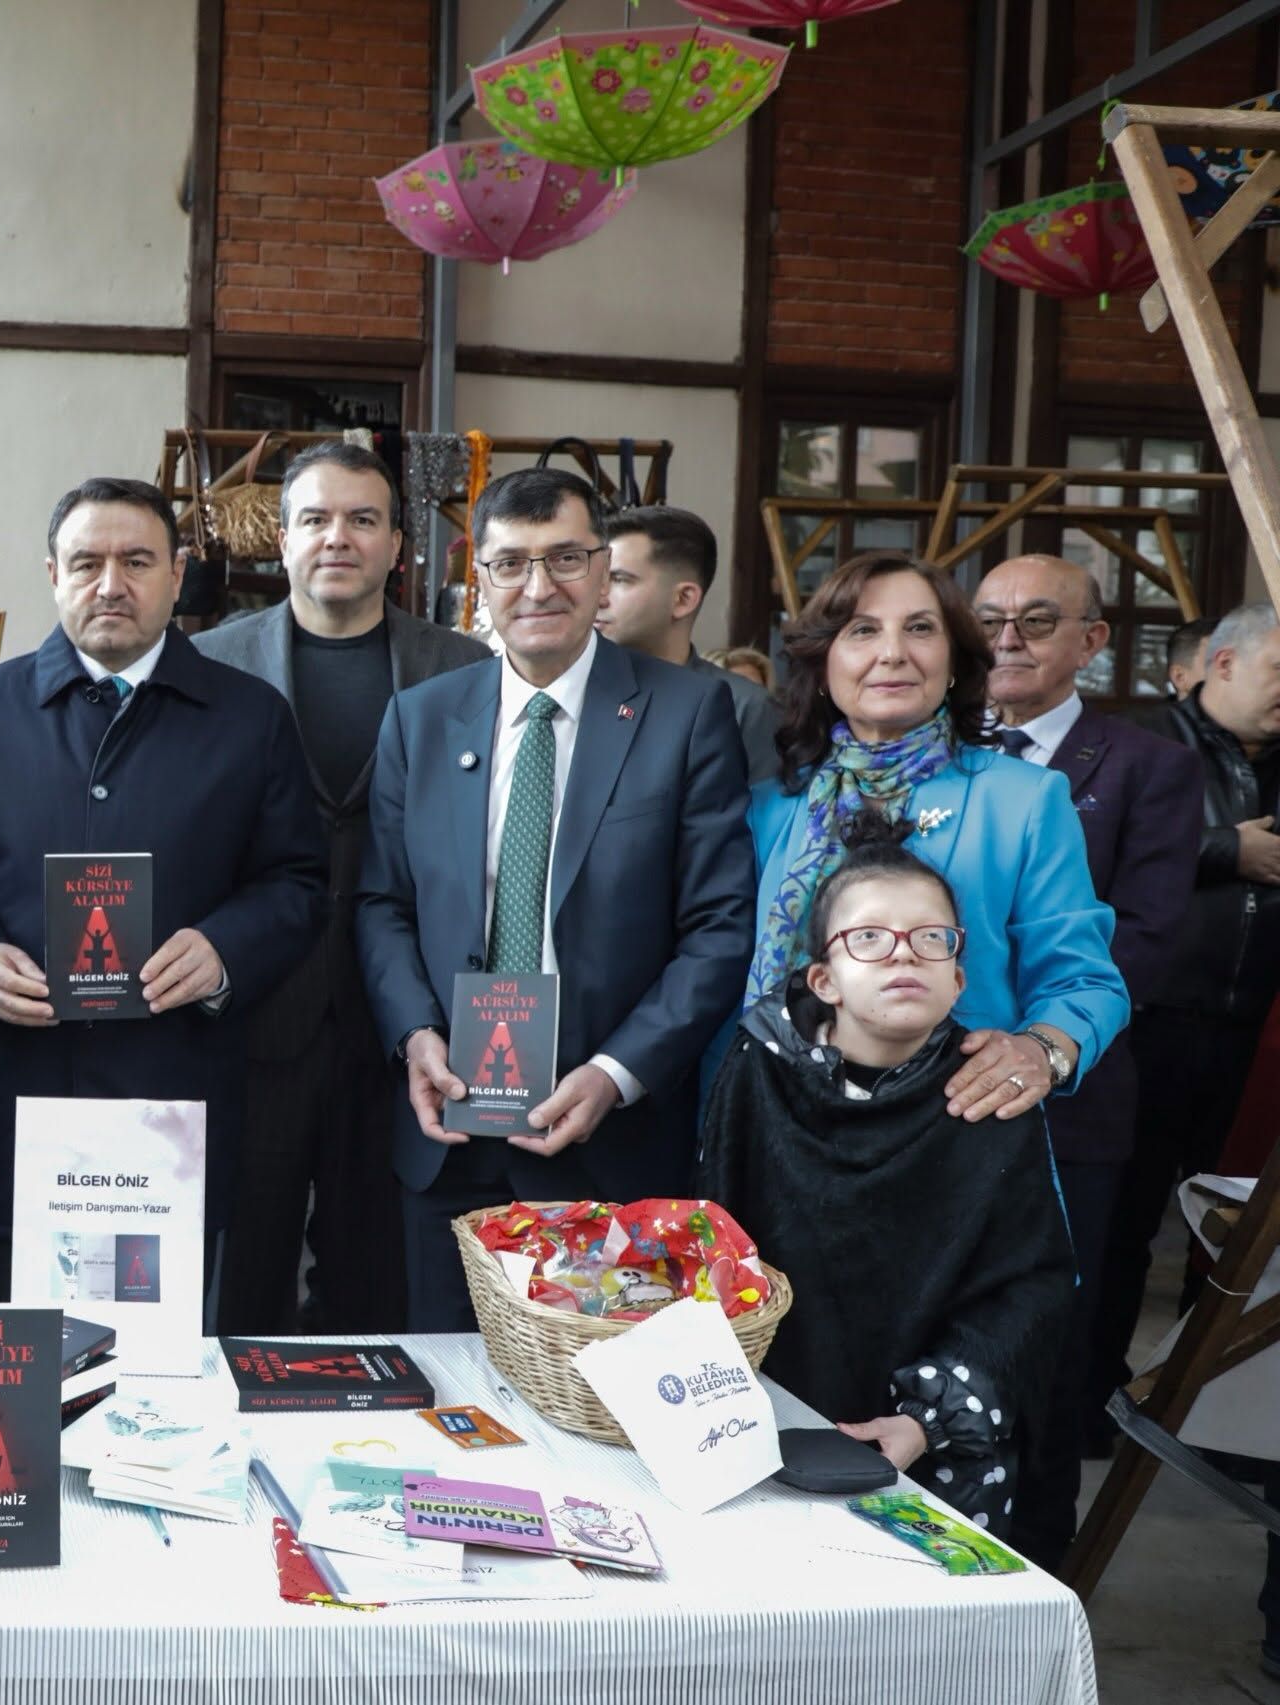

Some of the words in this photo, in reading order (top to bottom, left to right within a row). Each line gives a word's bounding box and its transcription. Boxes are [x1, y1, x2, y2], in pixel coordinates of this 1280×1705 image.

[85, 863, 113, 878] SİZİ
[65, 878, 134, 893] KÜRSÜYE
[72, 894, 127, 907] ALALIM
[69, 973, 104, 983] BİLGEN
[106, 971, 130, 982] ÖNİZ
[491, 980, 518, 993] SİZİ
[471, 994, 539, 1008] KÜRSÜYE
[478, 1009, 530, 1022] ALALIM
[468, 1086, 504, 1097] BİLGEN
[505, 1086, 530, 1097] ÖNİZ
[57, 1171, 111, 1188] BİLGEN
[114, 1173, 149, 1188] ÖNİZ
[417, 1514, 545, 1537] DERİN'İN
